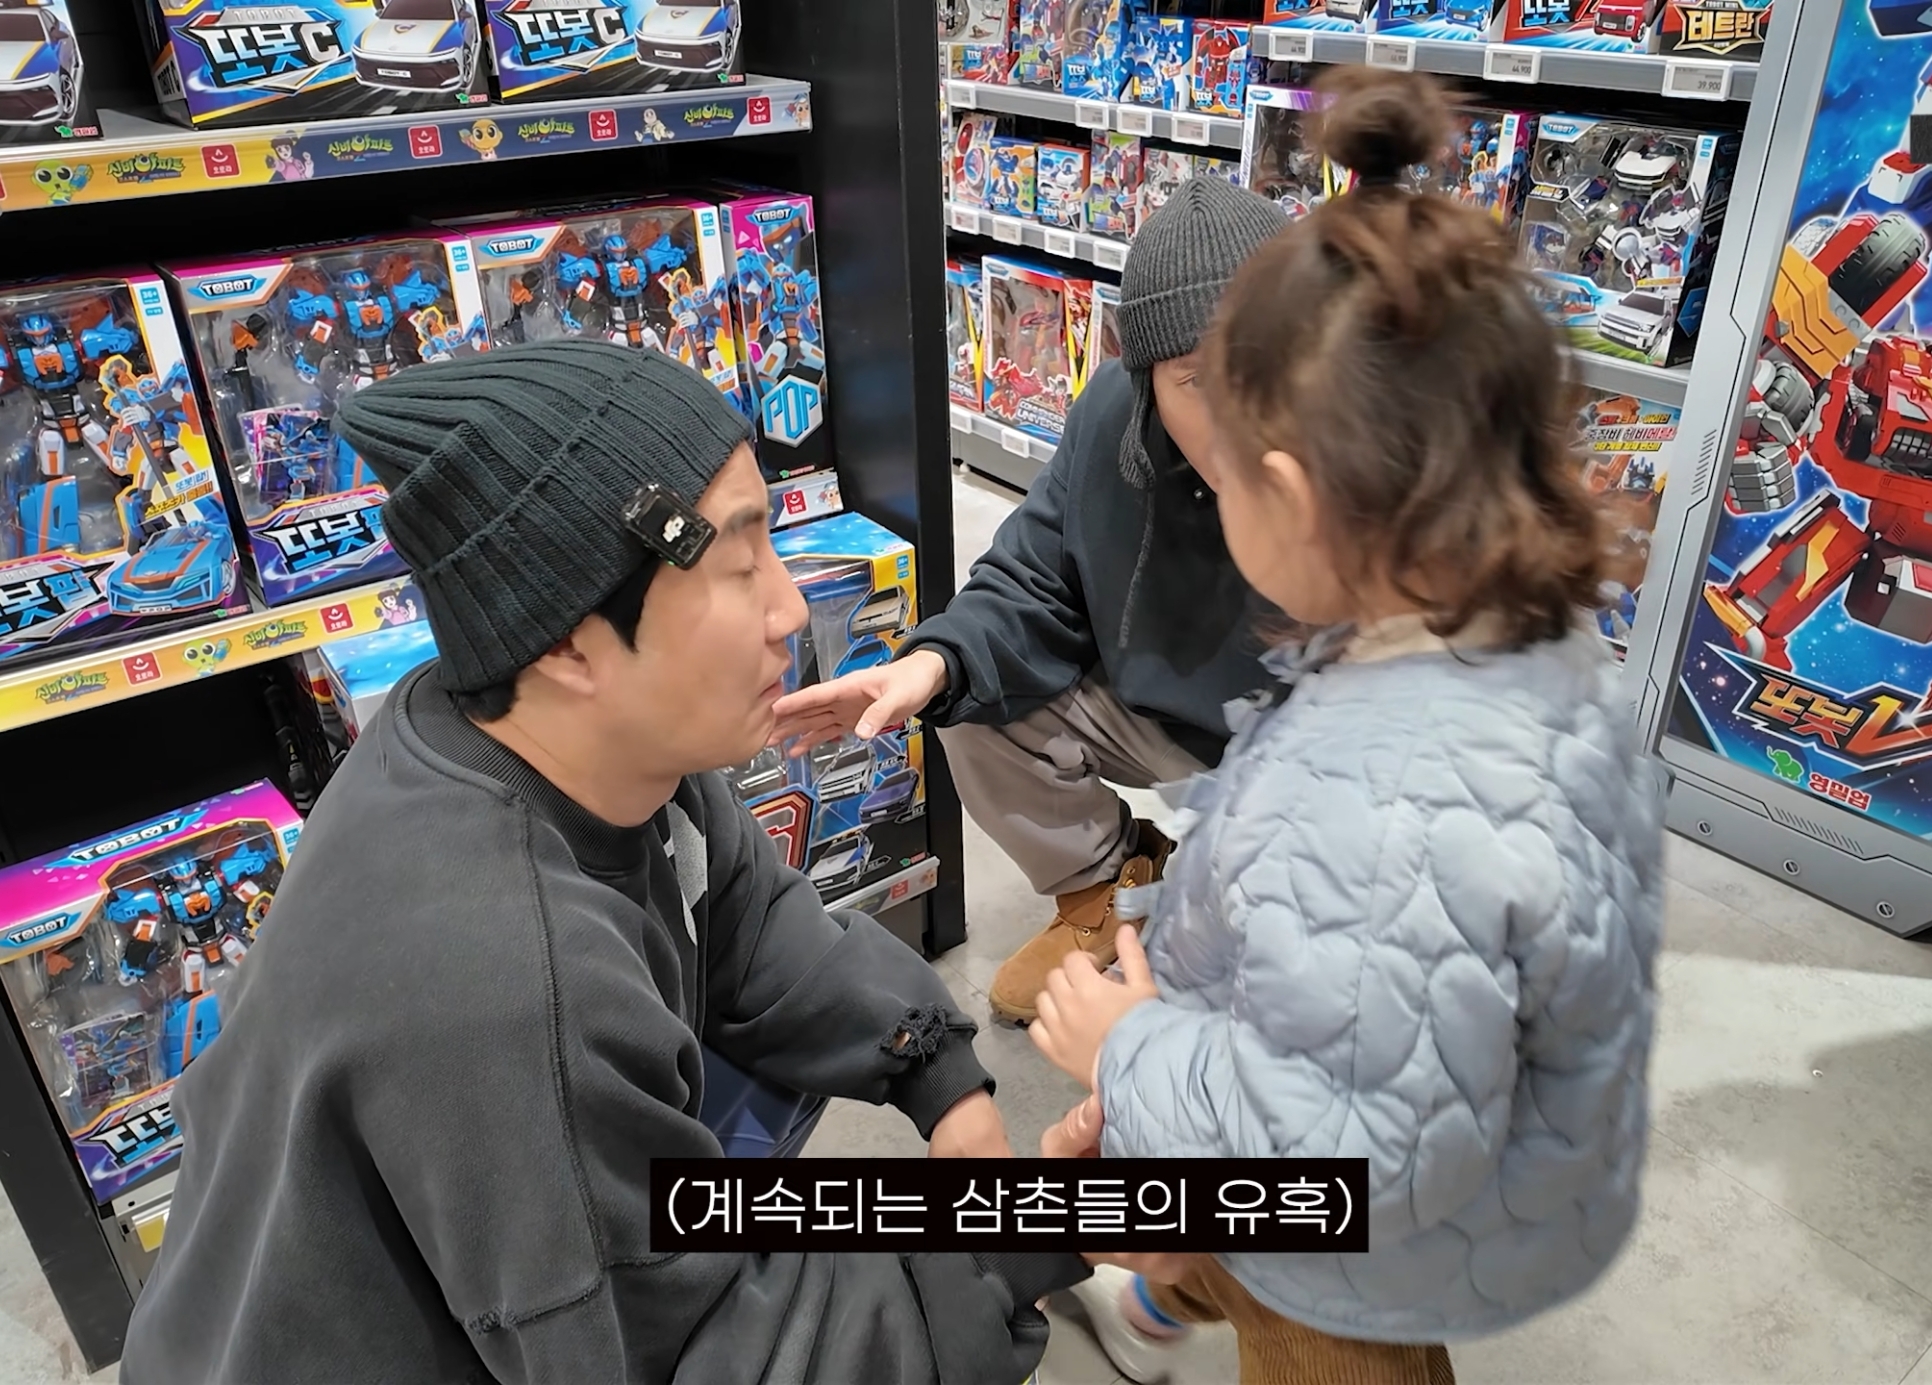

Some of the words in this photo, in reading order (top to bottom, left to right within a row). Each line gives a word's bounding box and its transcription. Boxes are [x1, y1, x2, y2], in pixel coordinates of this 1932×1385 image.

[194, 24, 307, 84] 또봇
[299, 24, 340, 62] C
[511, 10, 598, 63] 또봇
[592, 9, 625, 45] C
[107, 152, 186, 178] 신비아파트
[755, 208, 791, 221] TOBOT
[490, 235, 536, 253] TOBOT
[201, 279, 253, 296] TOBOT
[765, 380, 819, 440] POP
[263, 510, 370, 571] 또봇
[1751, 674, 1864, 749] 또봇
[72, 817, 181, 861] TOBOT
[9, 916, 67, 944] TOBOT
